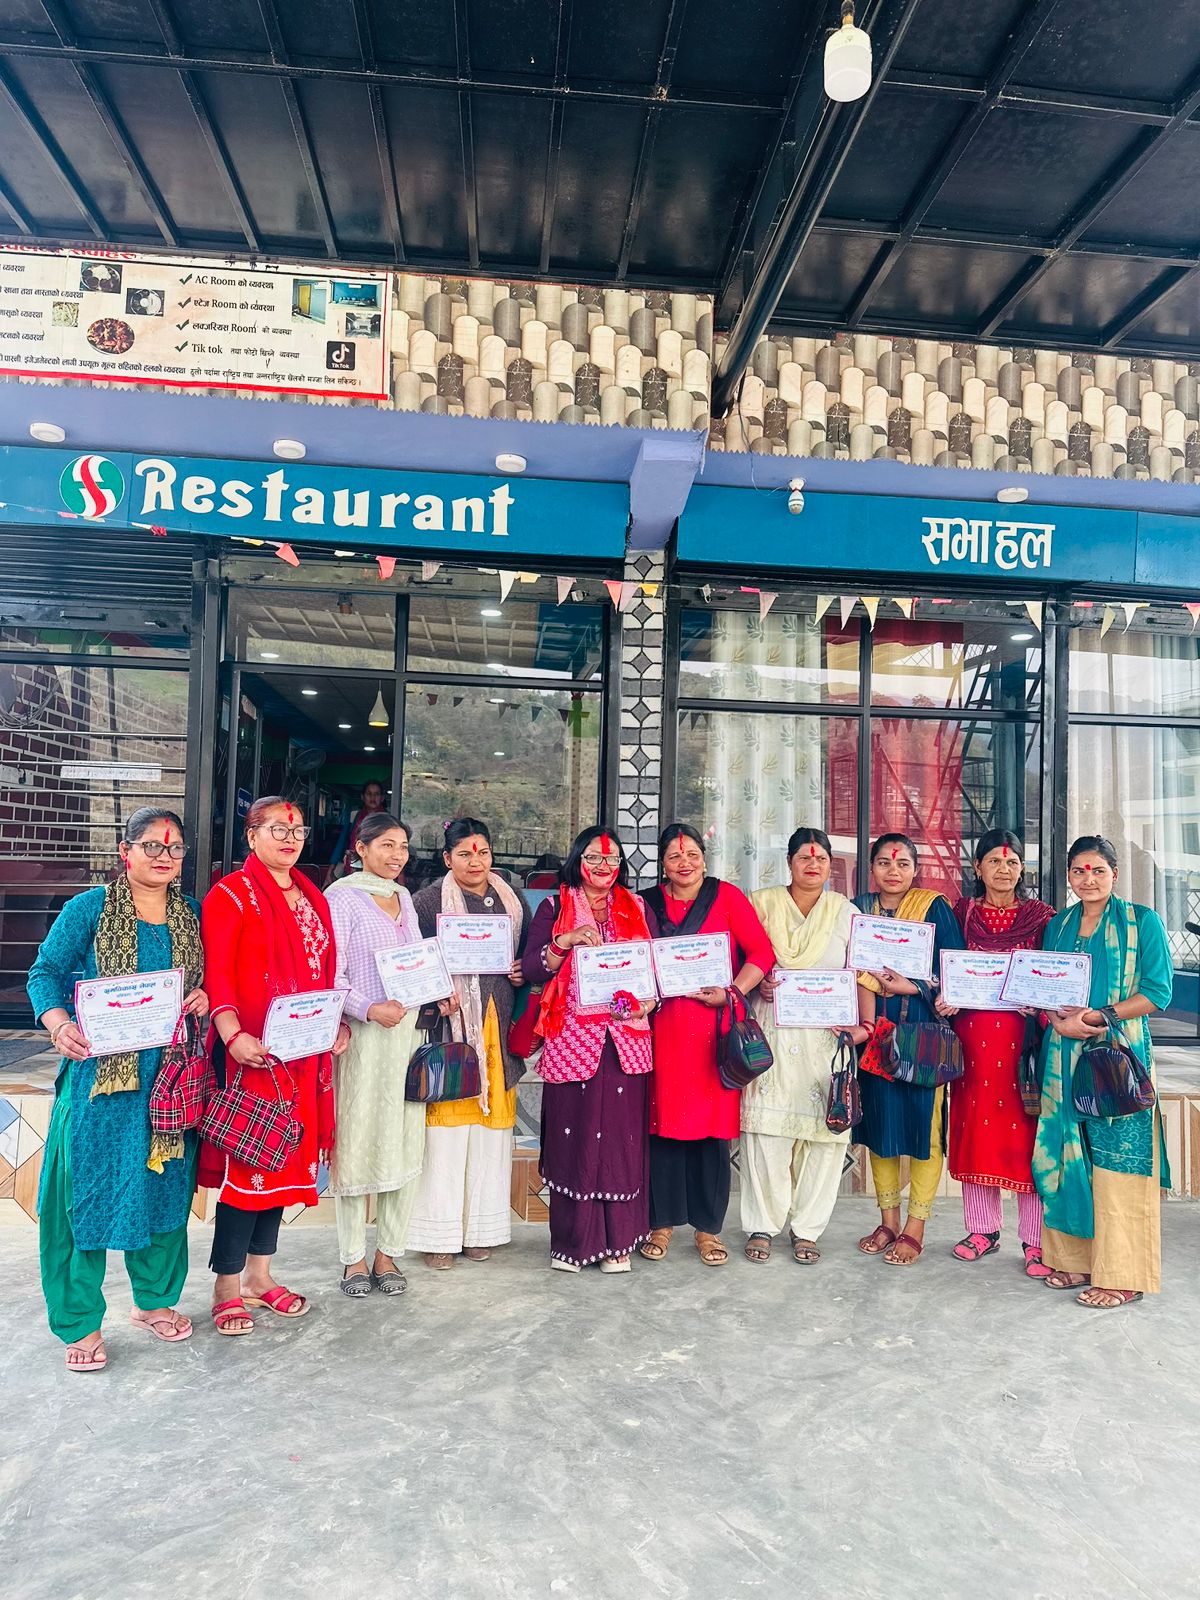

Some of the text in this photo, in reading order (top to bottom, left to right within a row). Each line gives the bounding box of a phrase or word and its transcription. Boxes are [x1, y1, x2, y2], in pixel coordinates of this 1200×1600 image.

[195, 275, 208, 285] AC
[210, 276, 236, 287] Room
[238, 278, 248, 288] को
[211, 299, 237, 310] Room
[239, 300, 249, 311] को
[231, 323, 257, 334] Room
[261, 326, 270, 334] को
[192, 343, 206, 353] Tik
[208, 345, 223, 354] tok
[135, 458, 515, 536] Restaurant
